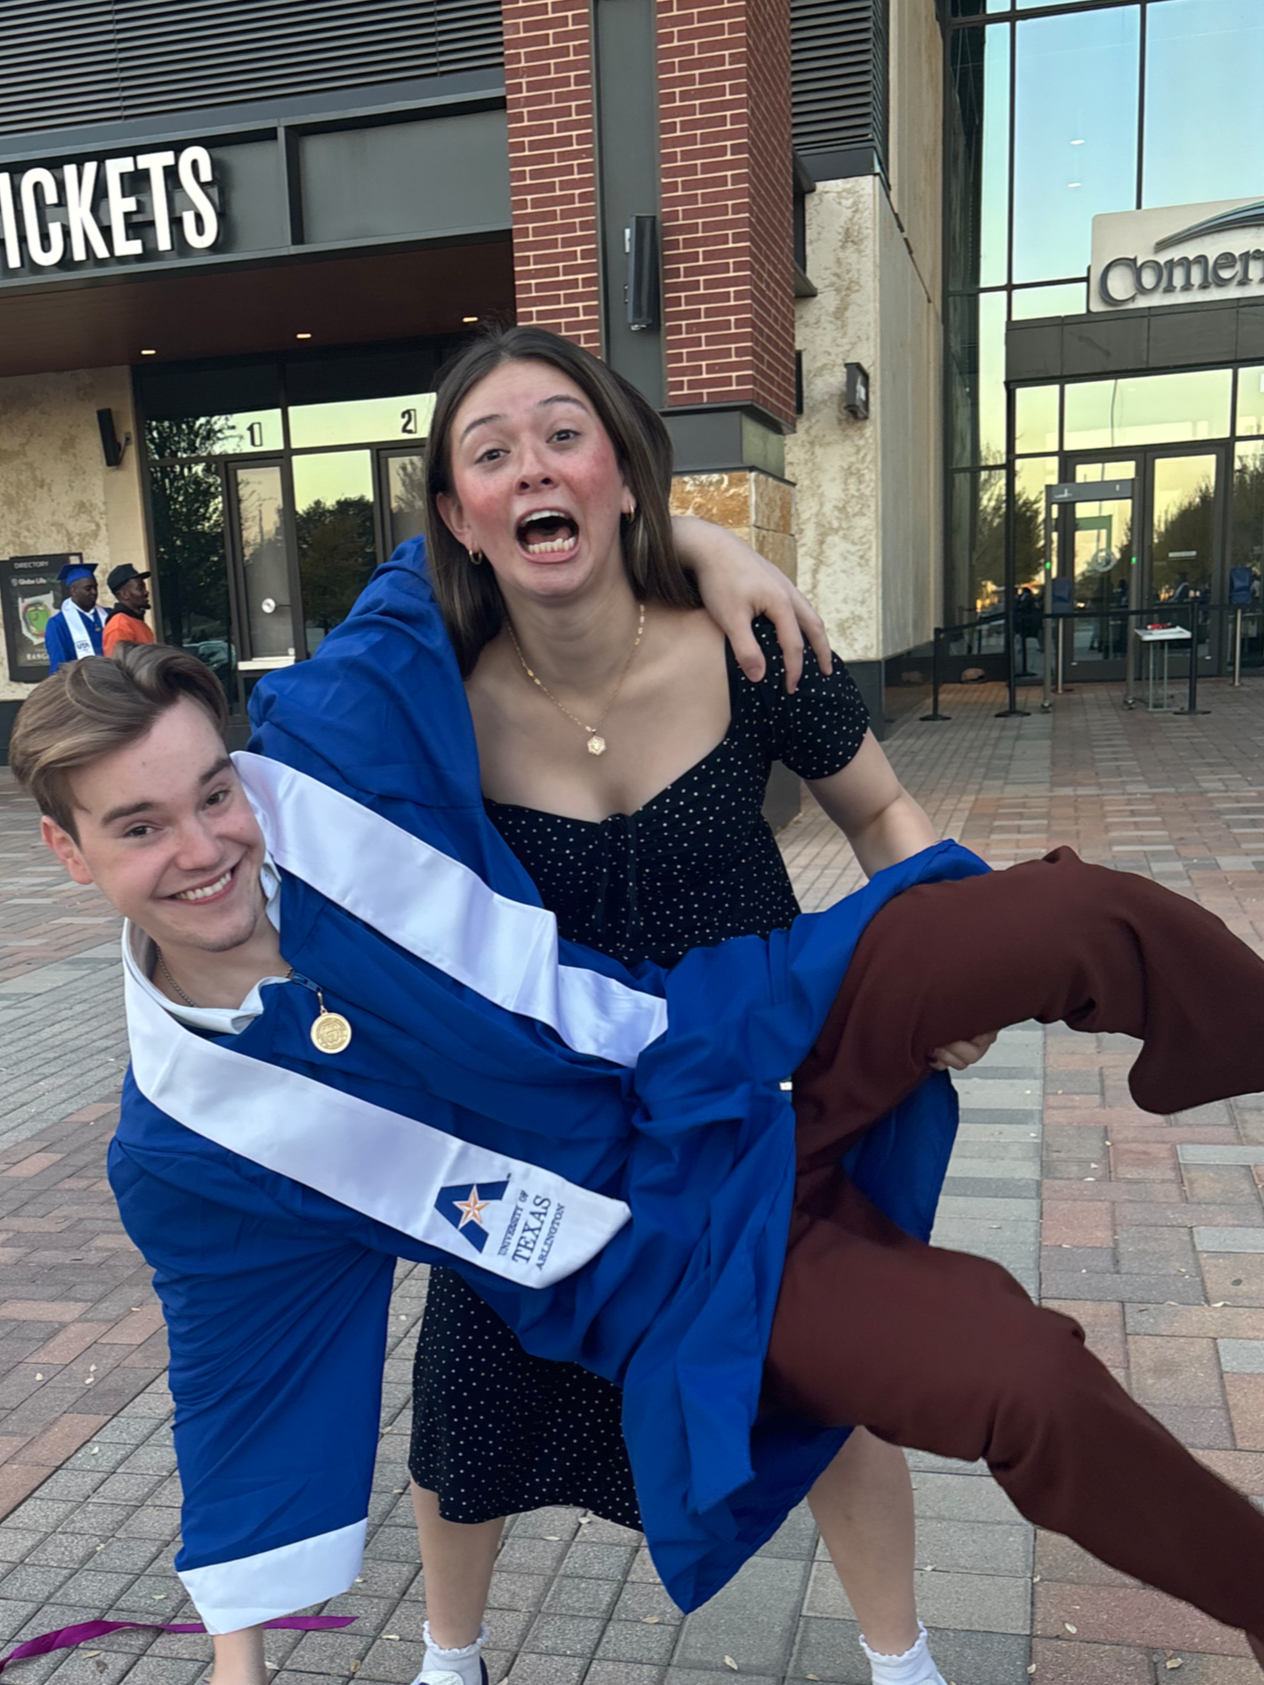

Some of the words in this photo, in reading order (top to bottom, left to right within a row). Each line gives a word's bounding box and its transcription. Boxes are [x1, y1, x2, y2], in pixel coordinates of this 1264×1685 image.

[246, 421, 263, 447] 1
[401, 408, 417, 434] 2
[14, 561, 48, 569] DIRECTORY
[498, 1204, 523, 1256] UNIVERSITY
[518, 1189, 529, 1203] OF
[511, 1194, 551, 1264] TEXAS
[536, 1202, 565, 1271] ARLINGTON
